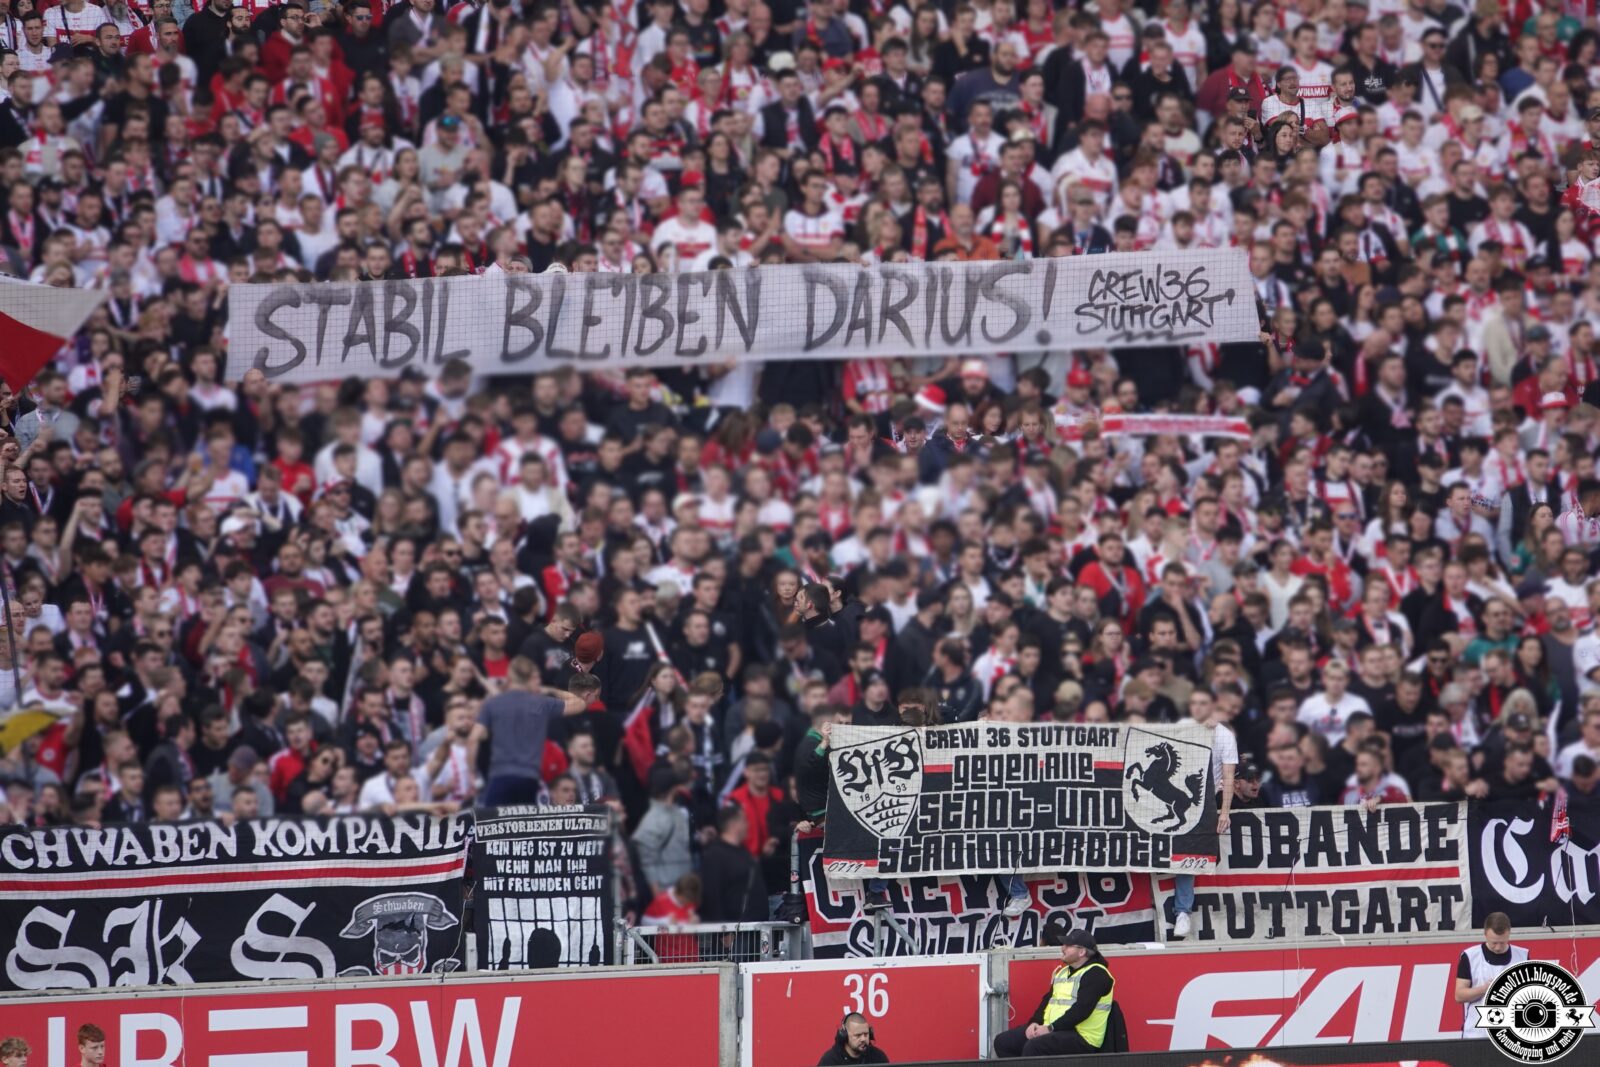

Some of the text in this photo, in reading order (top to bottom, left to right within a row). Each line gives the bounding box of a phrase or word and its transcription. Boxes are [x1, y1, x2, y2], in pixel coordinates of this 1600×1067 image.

[253, 259, 1057, 377] STABIL BLEIBEN DARIUS!
[1075, 287, 1235, 334] STUTTGART
[925, 726, 1120, 749] CREW 36 STUTTGART
[860, 783, 907, 803] 18 93
[476, 817, 608, 837] VERSTORBENEN ULTRAS
[1228, 803, 1460, 869] DBANDE
[0, 811, 469, 870] CHWABEN KOMPANIE
[486, 840, 604, 857] KEIN WEG IST ZU WEIT
[496, 859, 529, 874] WENN
[534, 859, 562, 874] MAN
[1179, 856, 1209, 869] 1312
[483, 875, 603, 892] MIT FREUNDEN GEHT
[372, 899, 425, 915] Schwaben
[842, 972, 890, 1018] 36
